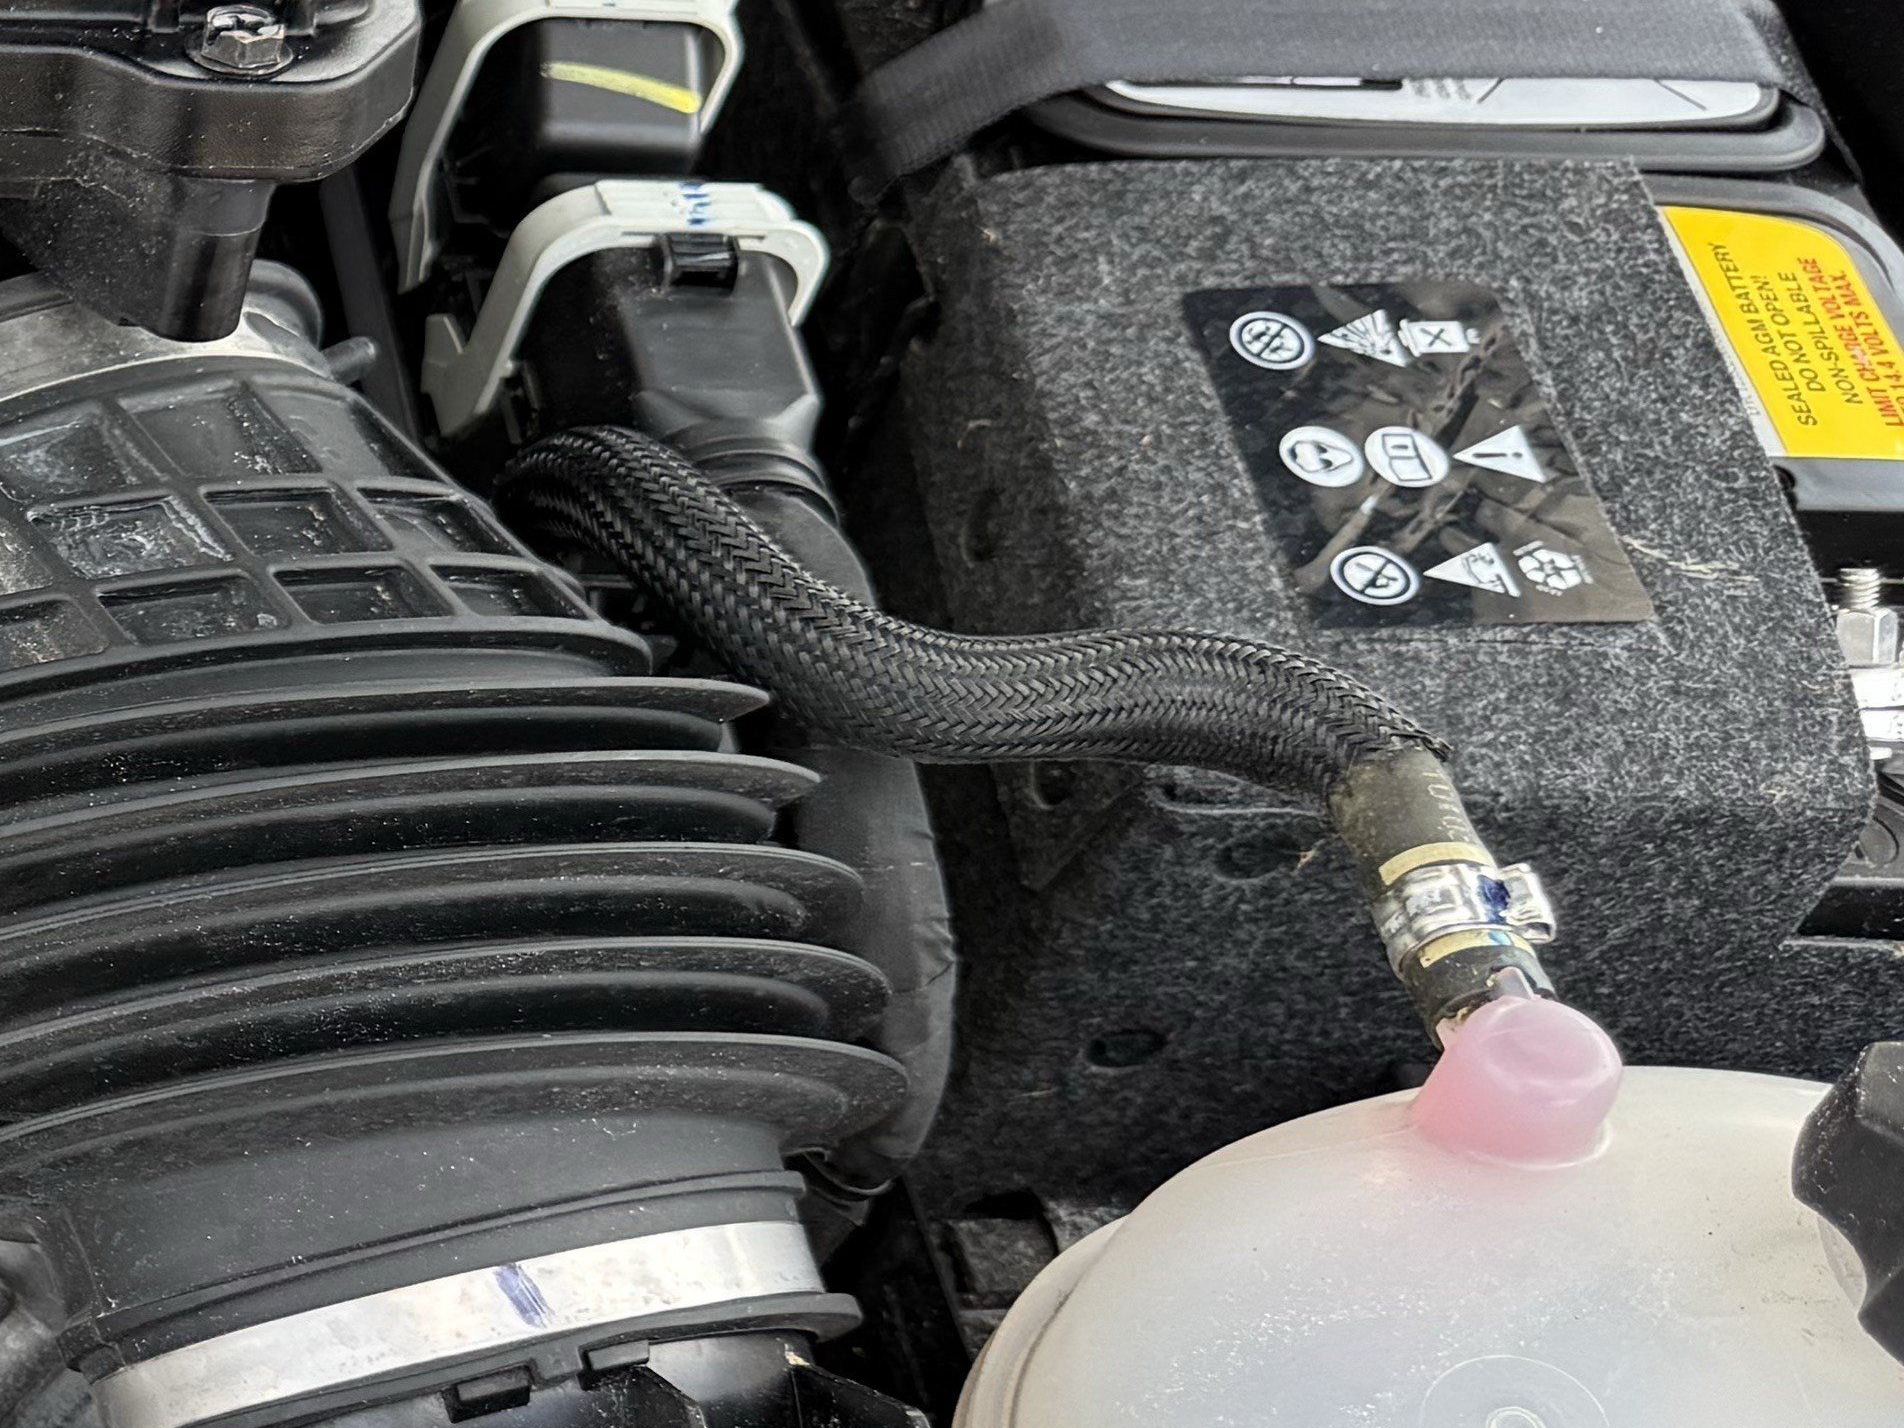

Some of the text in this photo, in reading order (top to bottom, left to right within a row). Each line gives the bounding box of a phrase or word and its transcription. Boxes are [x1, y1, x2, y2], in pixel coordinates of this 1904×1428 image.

[1708, 243, 1760, 314] BATTERY
[1746, 319, 1781, 357] AGM
[1777, 331, 1811, 364] NOT
[1778, 272, 1864, 404] NON-SPILLABLE
[1797, 258, 1904, 427] LIMIT CHARGE VOLTAGE
[1849, 311, 1889, 356] VOLTS
[1769, 362, 1818, 426] SEALED
[1799, 367, 1826, 392] DO
